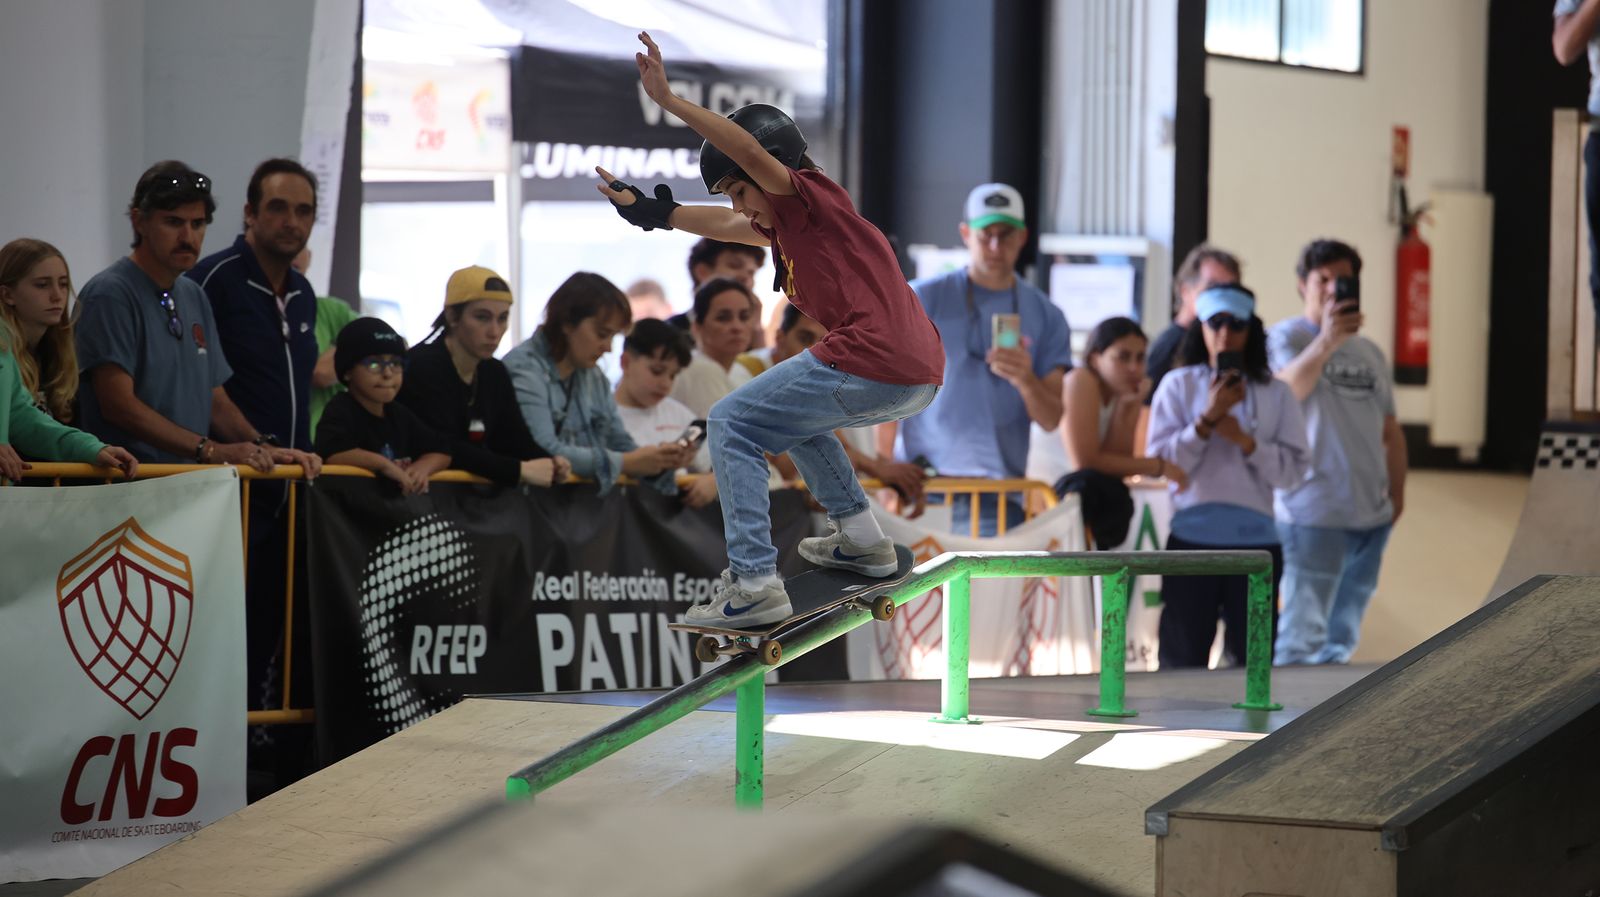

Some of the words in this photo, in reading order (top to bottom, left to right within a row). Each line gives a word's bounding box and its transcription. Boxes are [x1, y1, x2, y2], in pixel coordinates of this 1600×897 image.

[532, 571, 579, 601] Real
[583, 568, 669, 601] Federación
[673, 573, 724, 606] Espa
[410, 625, 487, 675] RFEP
[60, 727, 199, 825] CNS
[81, 827, 120, 840] NACIONAL
[121, 826, 133, 838] DE
